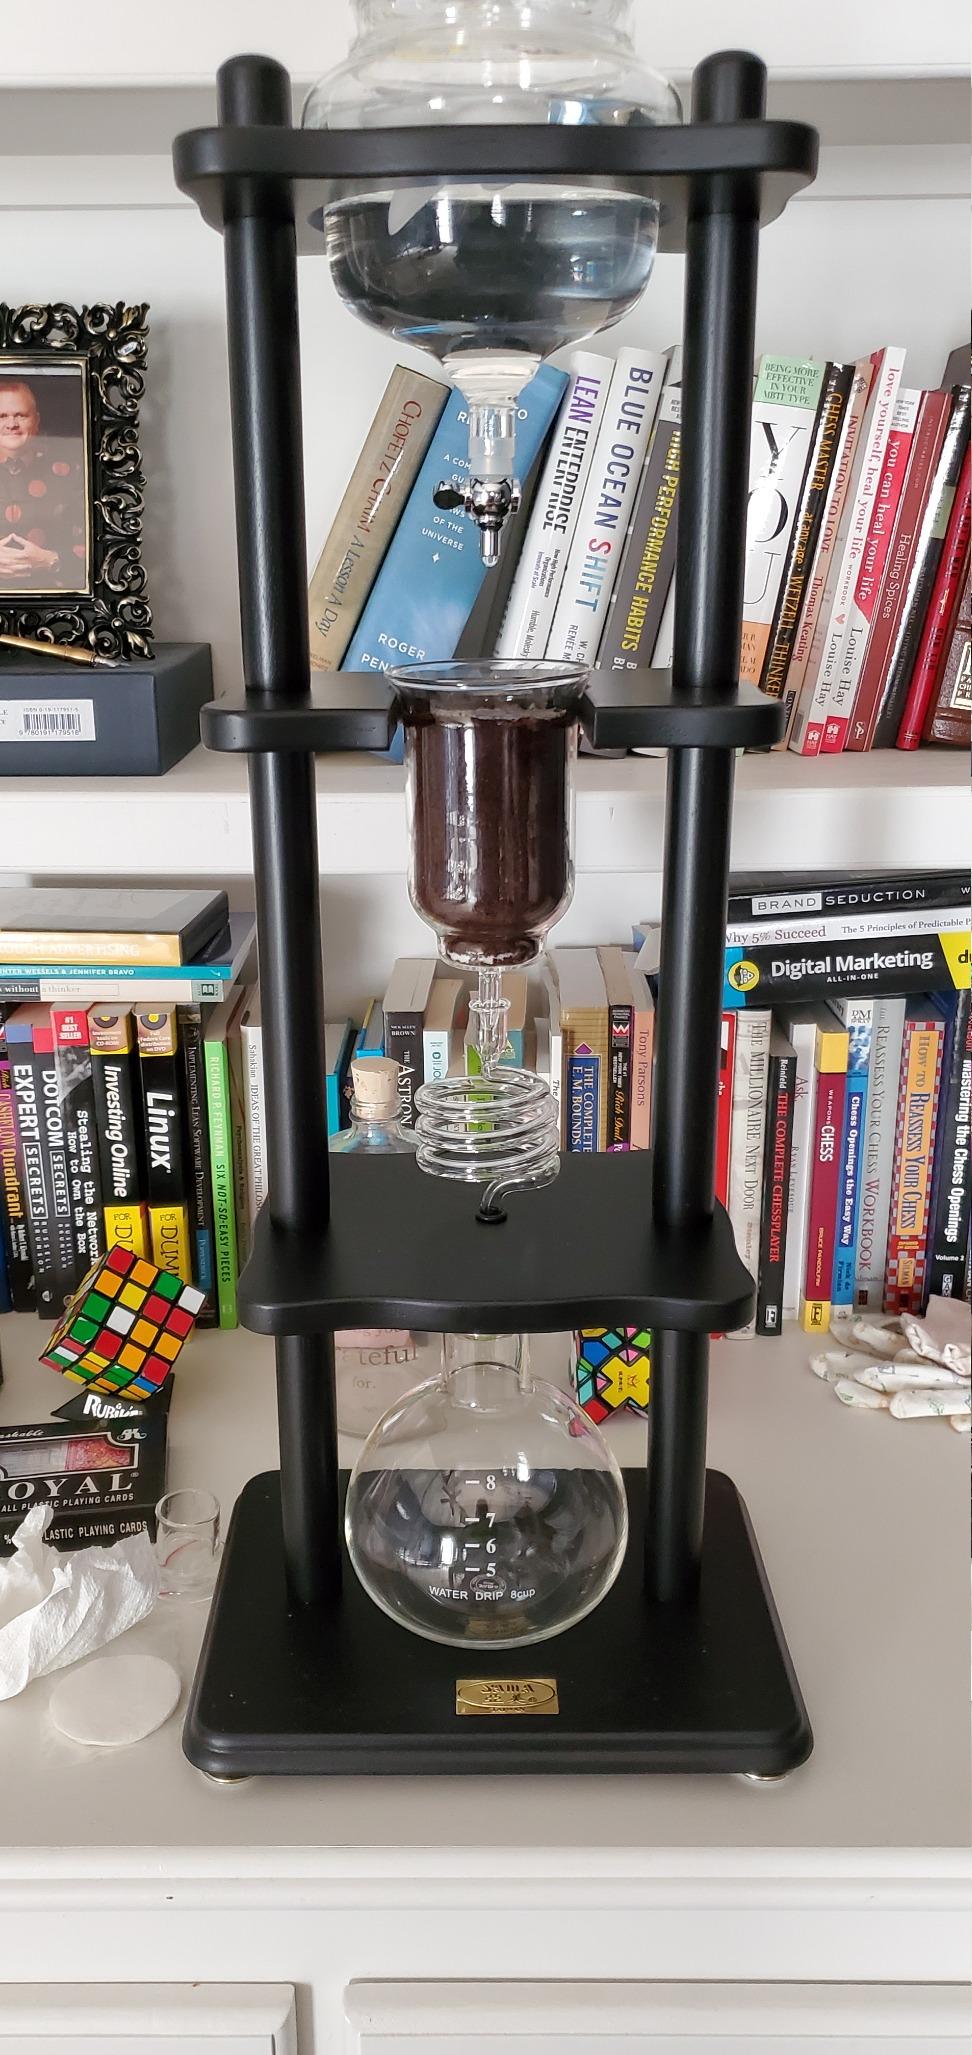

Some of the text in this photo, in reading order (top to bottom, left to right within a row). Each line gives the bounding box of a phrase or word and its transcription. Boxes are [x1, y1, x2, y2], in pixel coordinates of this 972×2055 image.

[765, 363, 819, 379] BEING MORE
[766, 372, 814, 387] EFFECTIVE
[770, 382, 806, 395] IN YOUR
[568, 376, 601, 424] LEAN
[788, 393, 810, 405] TYPE
[822, 392, 843, 437] CHESS
[443, 454, 450, 462] A
[811, 440, 833, 491] MASTER
[575, 367, 653, 613] BLUE OCEAN SHIFT
[820, 415, 858, 553] INVITATION TO LOVE
[841, 368, 900, 606] love yourself, heal your life WORKBOOK
[421, 527, 464, 551] UNIVERSE
[433, 516, 464, 534] OF THE
[634, 475, 679, 593] PERFORMANCE
[795, 512, 814, 565] at any age
[858, 437, 901, 601] you can heal your life
[882, 533, 912, 619] Healing Spices
[621, 596, 649, 652] HABITS
[792, 576, 823, 662] Thomas Keating
[378, 633, 425, 661] ROGER
[832, 627, 863, 706] Louise Hay
[815, 633, 842, 707] Louise Hay
[758, 889, 925, 910] BRAND SEDUCTION
[752, 926, 826, 943] 5% Succeed
[841, 918, 963, 934] The 5 Principles of Predictable
[108, 968, 135, 976] BRAVO
[771, 950, 934, 980] Digital Marketing
[826, 973, 879, 983] ALL-IN-ONE
[5, 984, 80, 993] without thinker
[59, 1032, 82, 1040] SELLER
[61, 1024, 78, 1032] BEST
[637, 1030, 649, 1106] Tony Parsons
[918, 1035, 930, 1067] HOW
[552, 1080, 560, 1097] The
[795, 1076, 808, 1100] Ask
[916, 1070, 926, 1088] TO
[248, 1044, 263, 1173] Sahakian IDEAS OF THE GREAT
[571, 1066, 582, 1145] E. M. BOUNDS
[583, 1066, 594, 1152] THE COMPLETE
[615, 1090, 625, 1116] Rich
[743, 1022, 768, 1210] THE MILLIONAIRE NEXT DOOR
[906, 1092, 931, 1152] REASSESS
[13, 1065, 45, 1217] EXPERT SECRETS
[42, 1071, 68, 1214] DOTCOM SECRETS
[104, 1065, 131, 1198] Investing Online
[146, 1091, 175, 1169] Linux
[820, 1089, 835, 1162] WEAPONS CHESS
[76, 1110, 96, 1205] Stealing the
[769, 1059, 789, 1262] Reinfeld THE COMPLETE CHESSPLAYER
[859, 1025, 890, 1271] REASSESS YOUR CHESS WORKBOOK
[945, 1060, 971, 1243] Mastering the Chess Openings
[2, 1148, 24, 1219] Quadrant
[210, 1057, 231, 1284] RICHARD FEYNMAN SIX NOT-SO-EASY PIECES
[841, 1096, 860, 1246] Chess Openings the Easy Way
[903, 1154, 926, 1188] YOUR
[66, 1131, 87, 1254] How to Own the Box
[901, 1192, 922, 1229] CHESS
[113, 1212, 132, 1221] FOR
[160, 1213, 177, 1222] FOR
[33, 1221, 45, 1273] BRUNSON
[816, 1227, 824, 1248] BRUCE
[1, 1504, 18, 1512] ALL
[63, 1496, 100, 1506] PLAYING
[104, 1493, 134, 1502] CARDS
[486, 1475, 495, 1490] 8
[79, 1521, 148, 1537] PLAYING CARDS
[486, 1512, 496, 1528] 7
[486, 1538, 497, 1554] 6
[486, 1562, 497, 1577] 5
[429, 1585, 536, 1600] WATER DRIP 8cup
